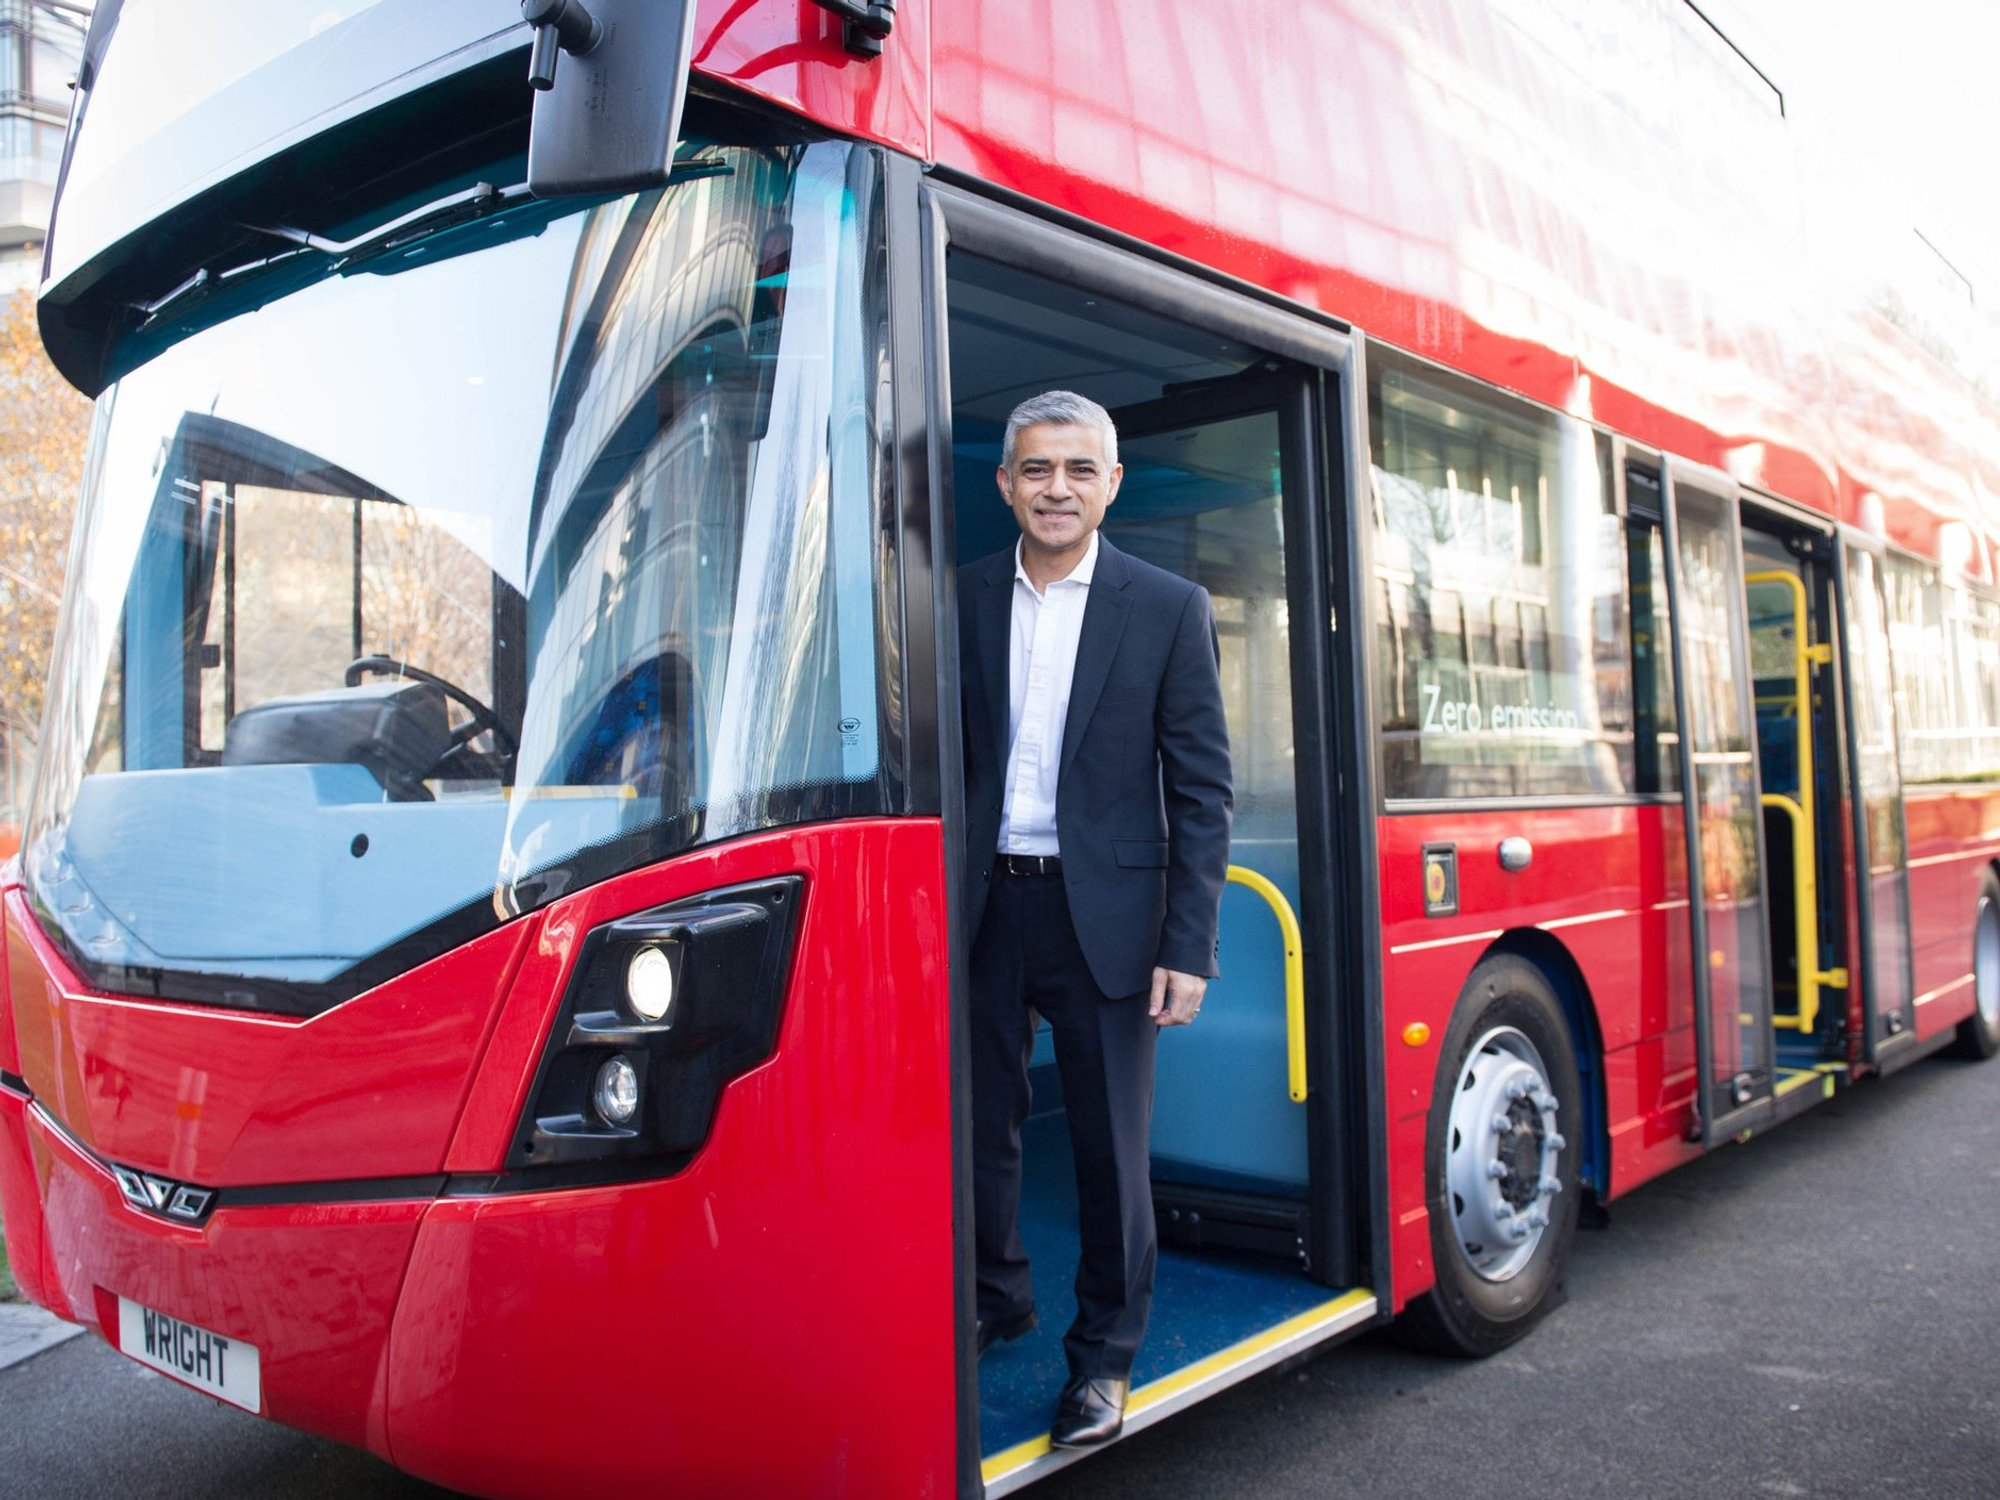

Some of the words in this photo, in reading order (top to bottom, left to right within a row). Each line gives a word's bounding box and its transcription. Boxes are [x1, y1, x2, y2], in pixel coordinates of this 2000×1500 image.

[1423, 685, 1482, 733] Zero
[1491, 699, 1578, 735] emission
[144, 1308, 228, 1387] WRIGHT
